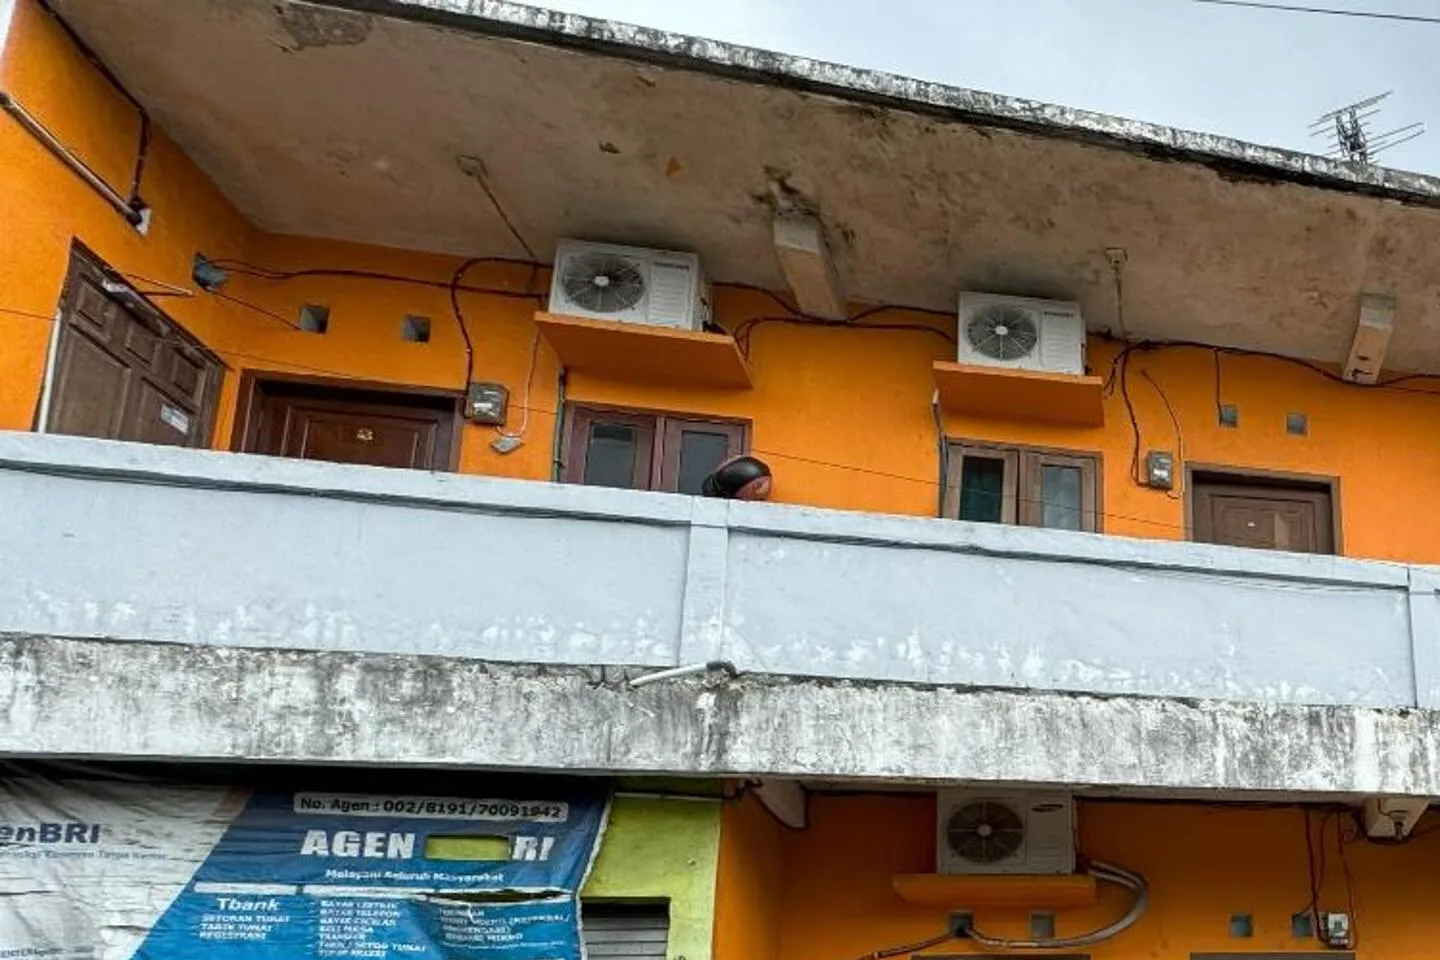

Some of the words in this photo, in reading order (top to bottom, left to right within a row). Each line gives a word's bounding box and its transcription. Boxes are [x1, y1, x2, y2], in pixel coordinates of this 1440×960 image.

[331, 799, 370, 812] Agen
[300, 829, 416, 859] AGEN
[216, 897, 281, 911] Tbank
